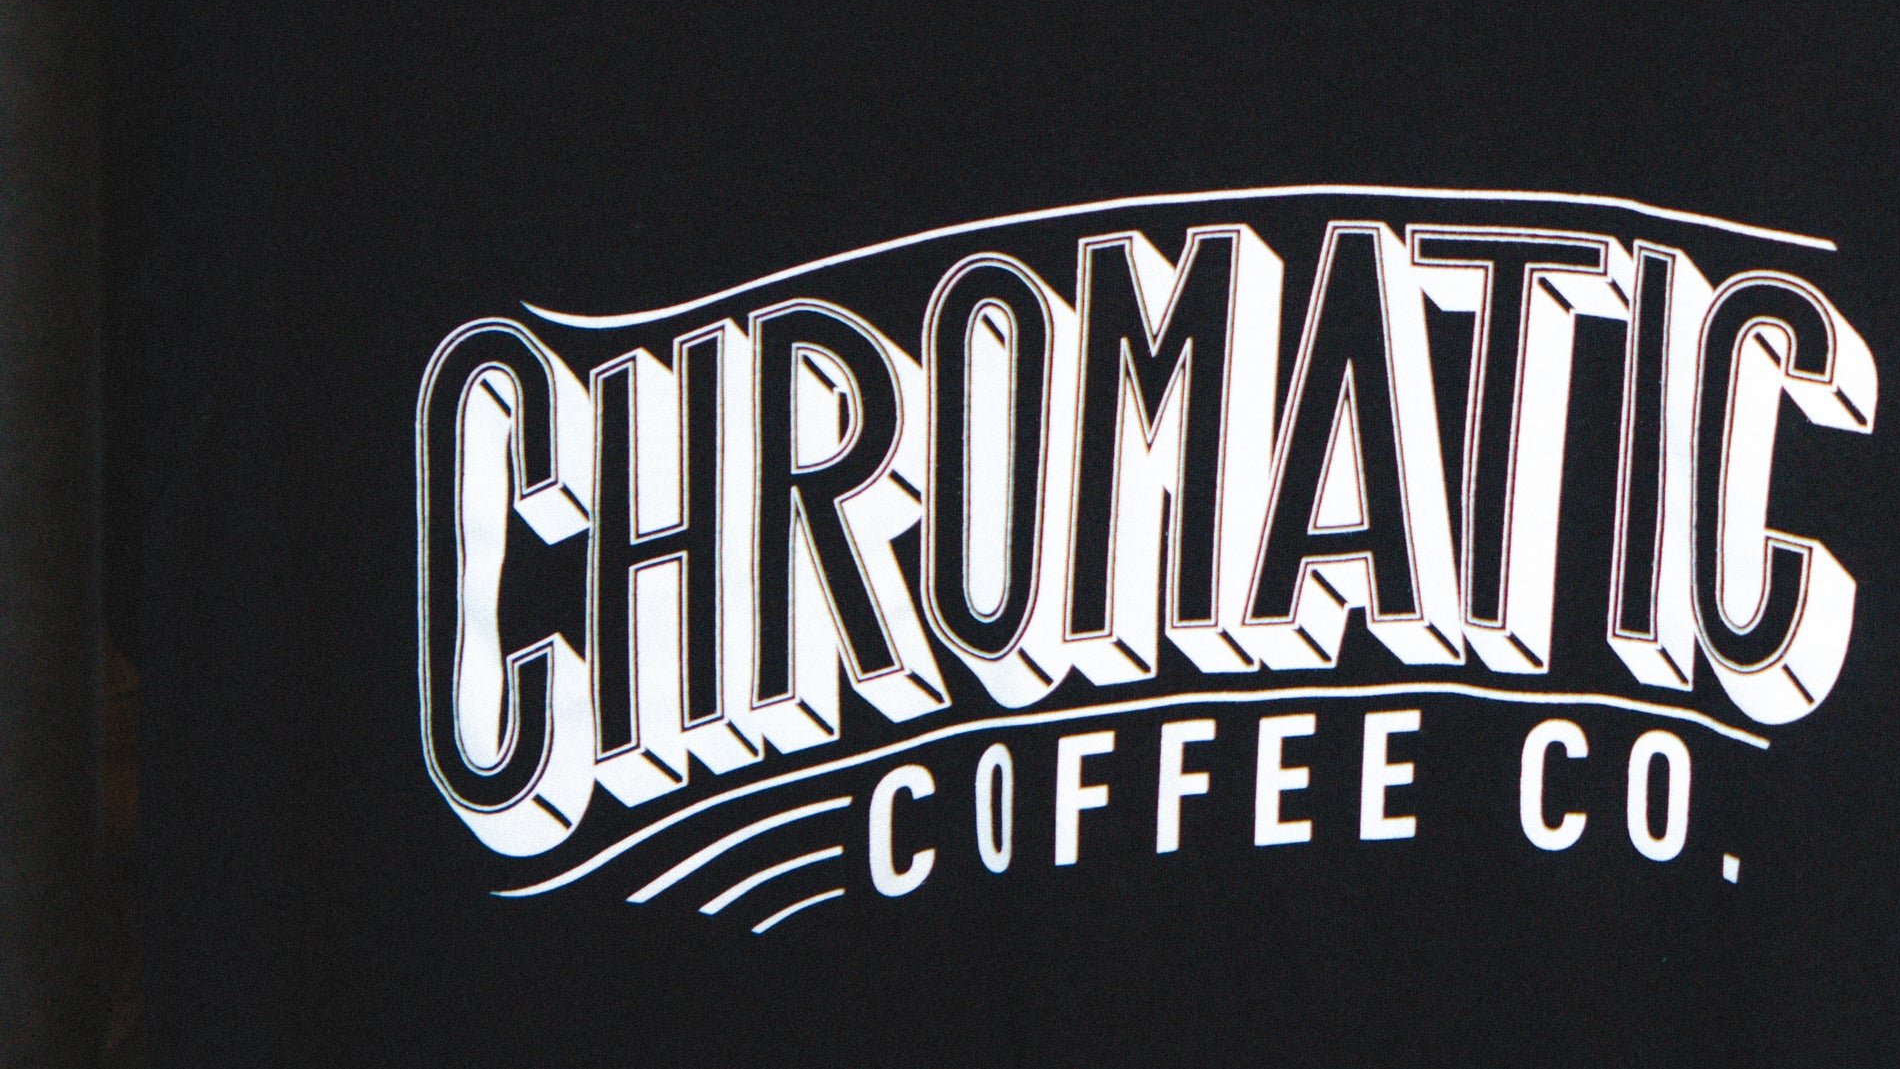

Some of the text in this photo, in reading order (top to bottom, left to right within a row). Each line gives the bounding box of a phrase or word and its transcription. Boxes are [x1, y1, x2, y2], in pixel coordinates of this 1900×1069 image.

[415, 219, 1879, 858] CHROMATIC
[868, 709, 1741, 898] COFFEE CO.
